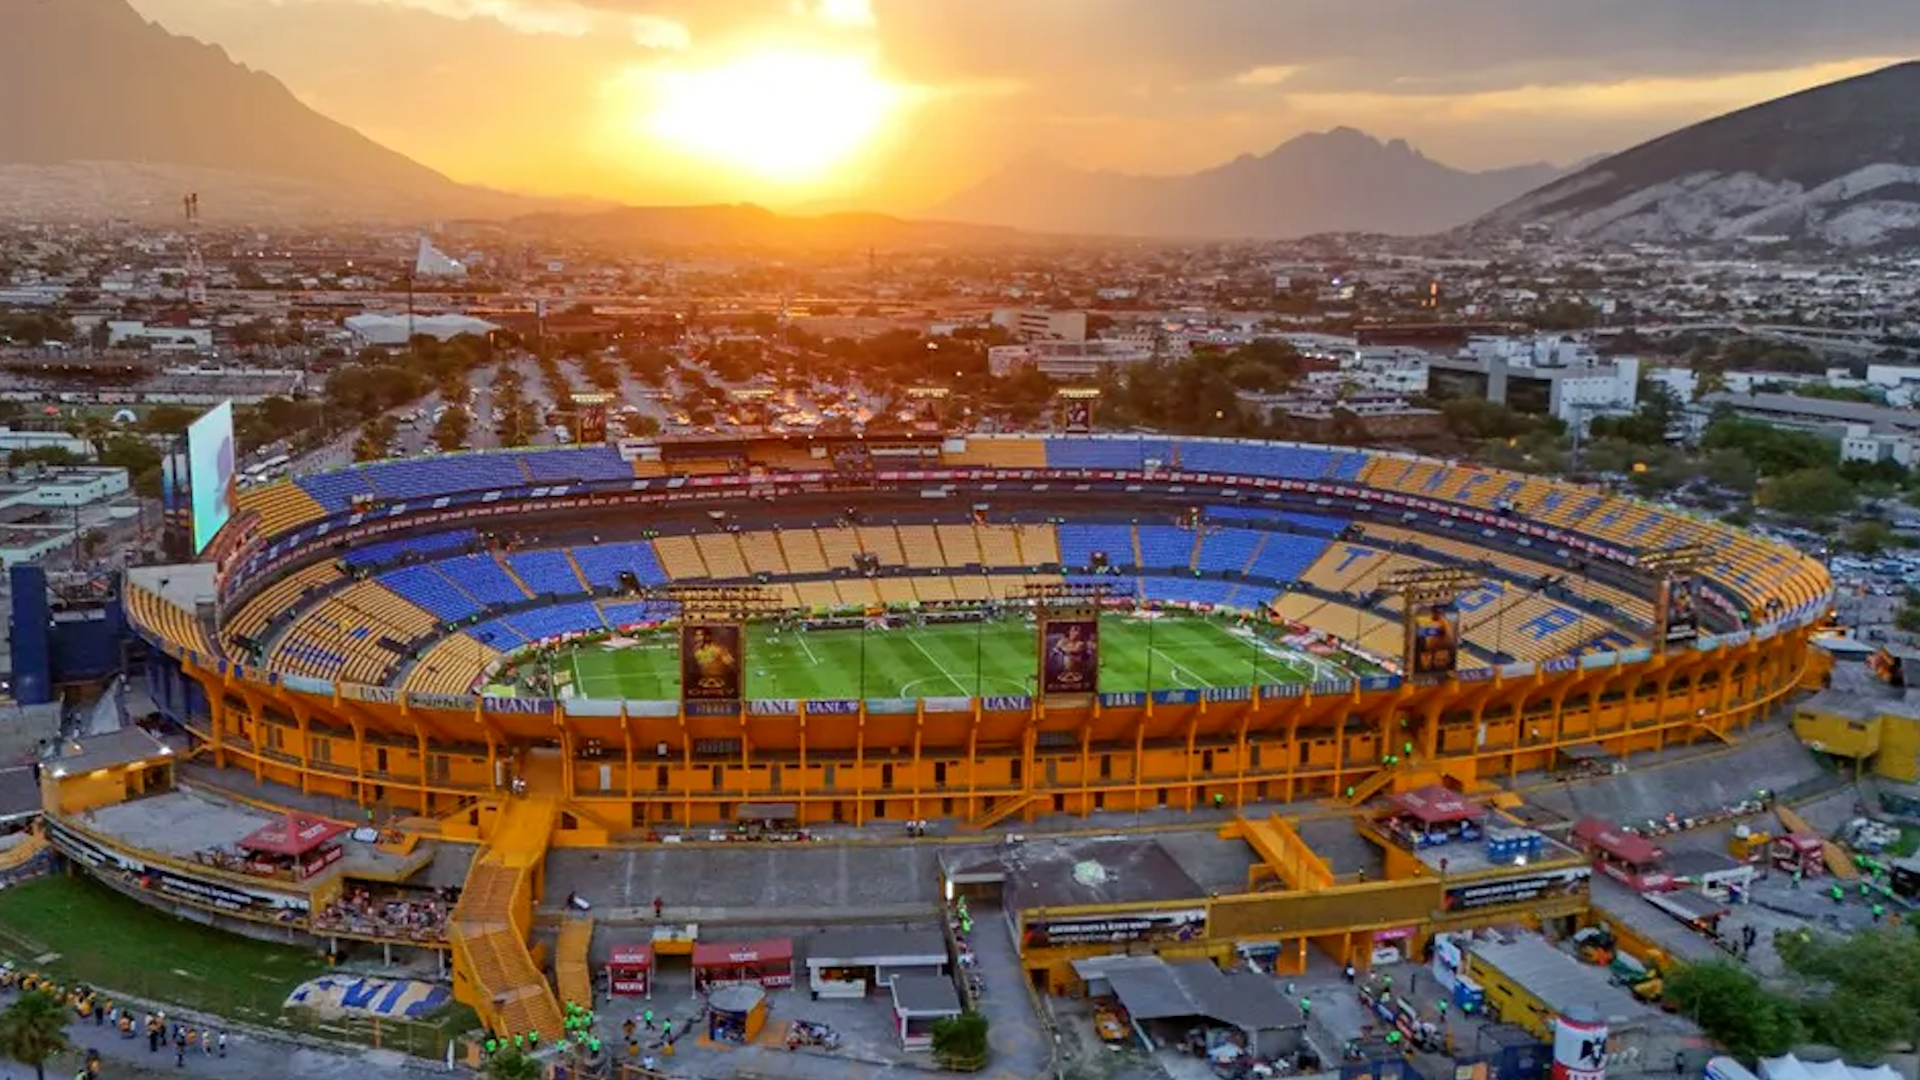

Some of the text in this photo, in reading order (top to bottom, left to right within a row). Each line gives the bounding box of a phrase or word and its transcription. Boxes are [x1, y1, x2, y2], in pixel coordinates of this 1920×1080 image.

[496, 698, 541, 713] UANL
[983, 696, 1029, 711] UANL
[1105, 693, 1137, 706] UANL
[752, 700, 796, 714] UANL
[806, 701, 845, 714] UANL
